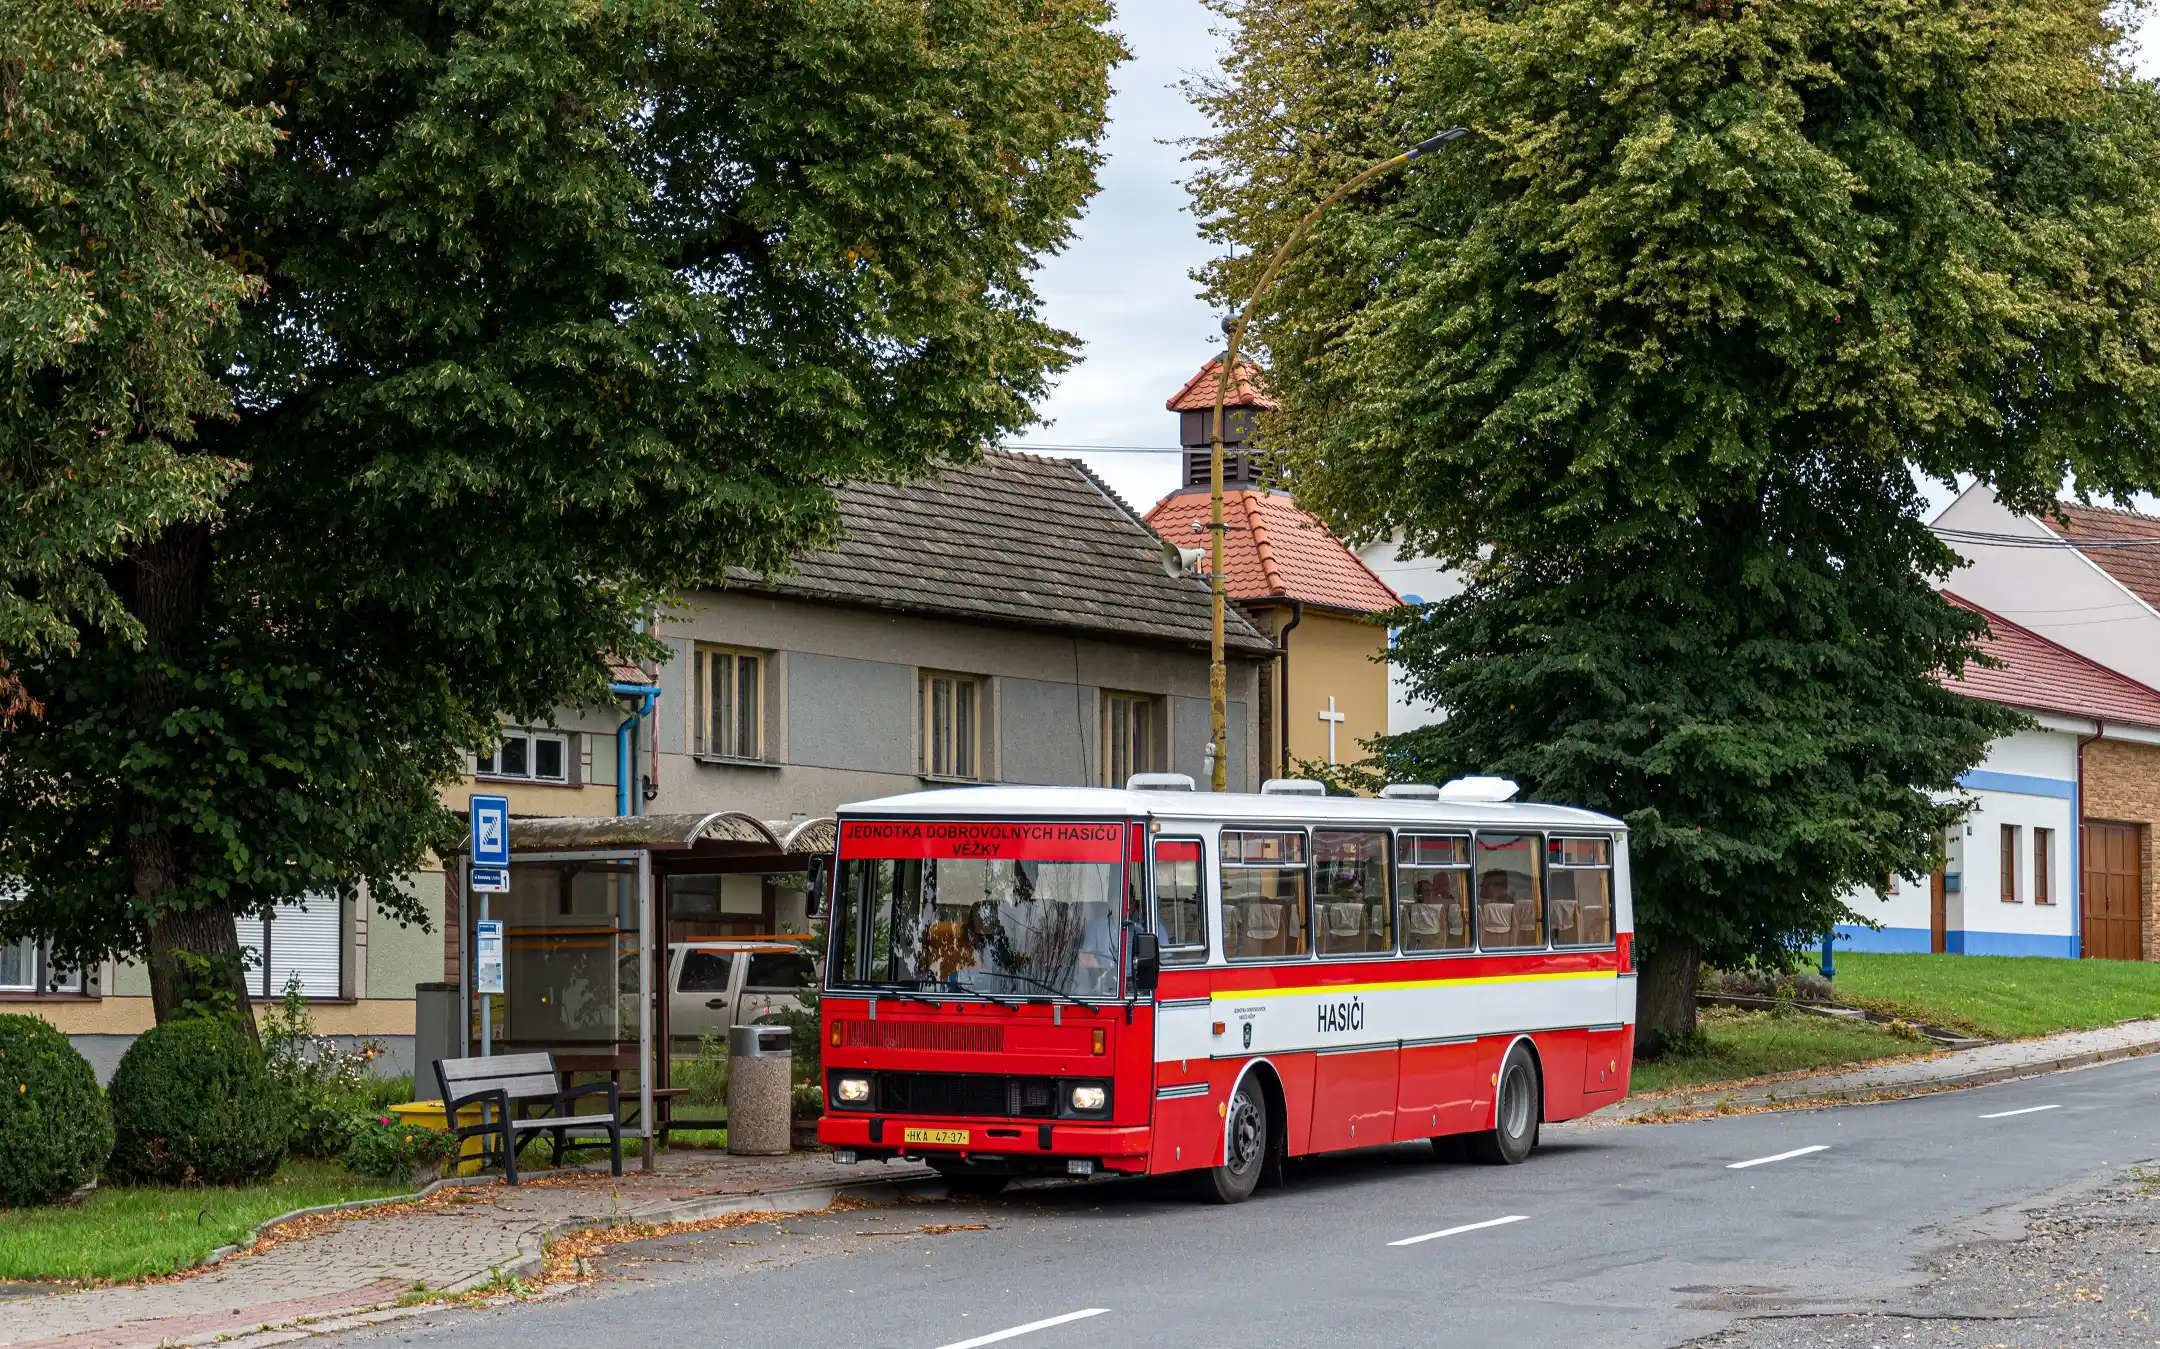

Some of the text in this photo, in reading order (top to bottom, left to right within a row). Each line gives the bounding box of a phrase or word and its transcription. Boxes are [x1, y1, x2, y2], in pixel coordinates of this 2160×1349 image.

[847, 824, 1117, 841] JEDNOTKA DOBROVOLNÝCH HASIČŮ
[952, 840, 1000, 856] VĚŽKY
[1317, 995, 1364, 1033] HASIČI
[909, 1130, 963, 1143] HKA 47-37
